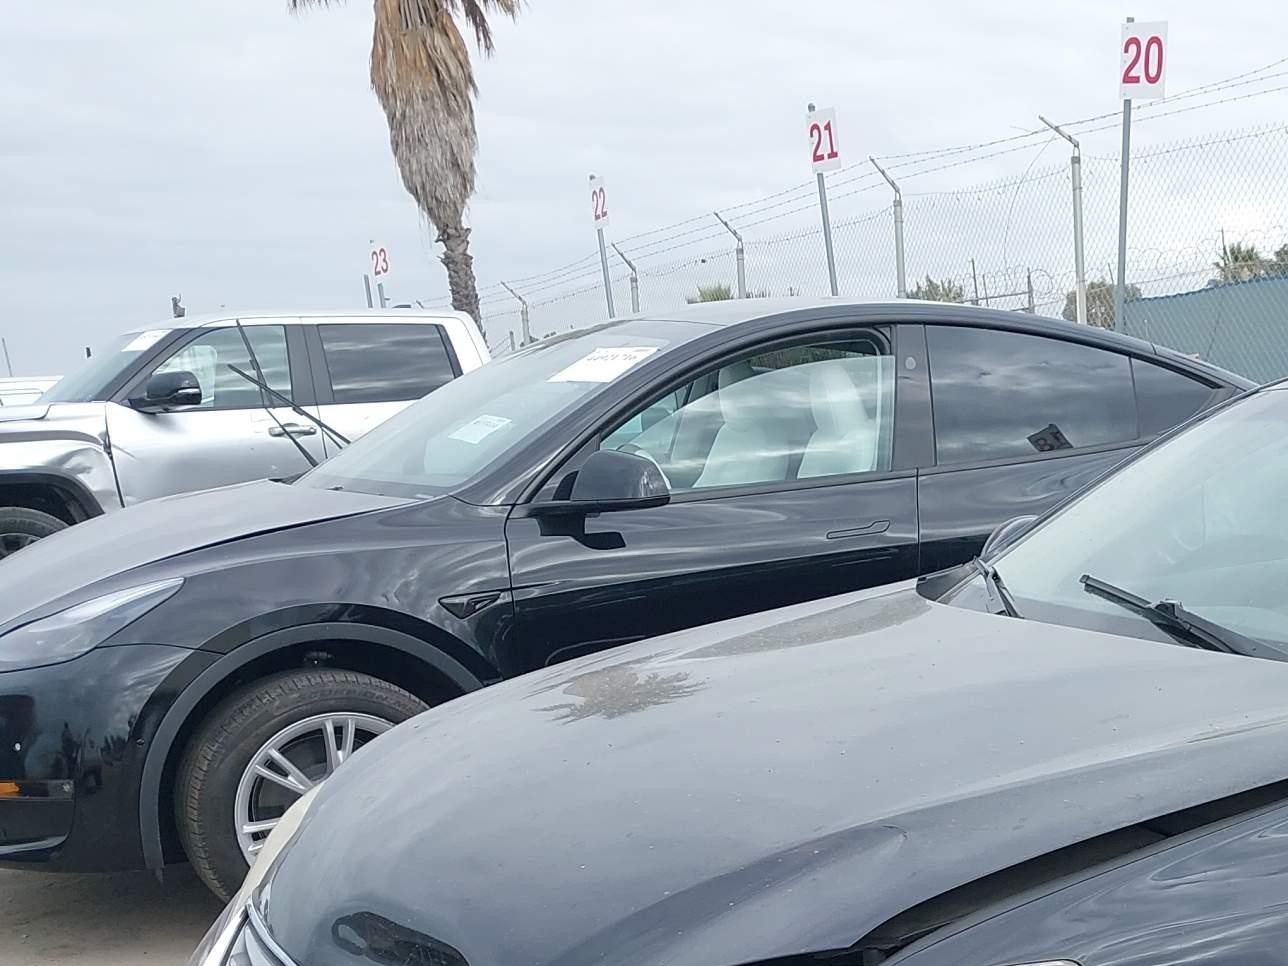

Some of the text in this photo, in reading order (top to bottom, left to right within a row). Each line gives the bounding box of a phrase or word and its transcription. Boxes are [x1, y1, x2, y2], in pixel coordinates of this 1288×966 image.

[1121, 36, 1164, 85] 20
[810, 121, 838, 162] 21
[591, 187, 608, 221] 22
[371, 248, 389, 276] 23
